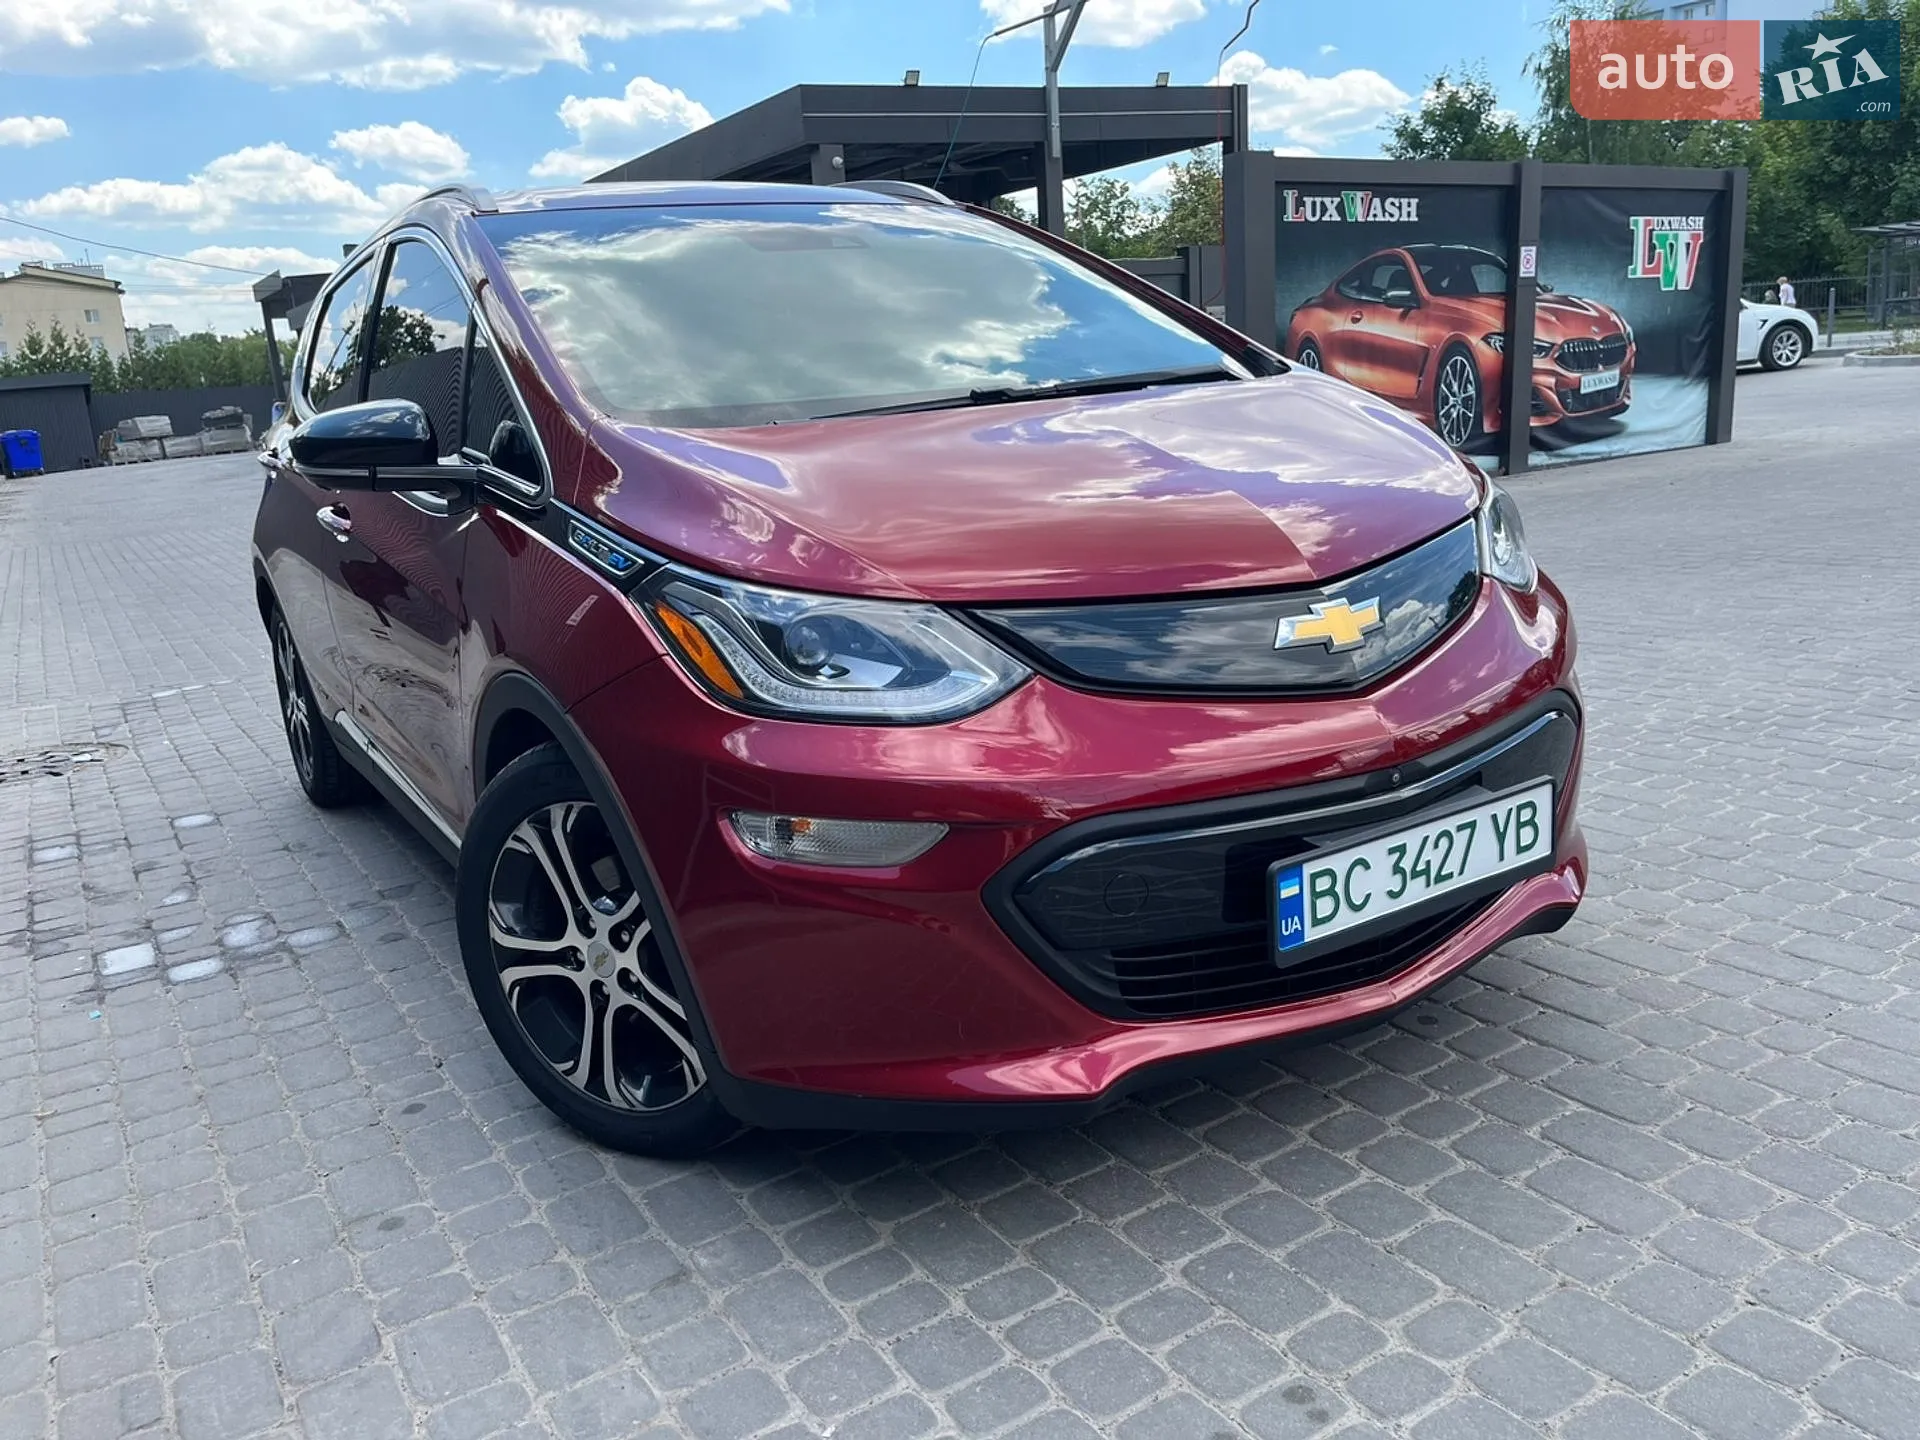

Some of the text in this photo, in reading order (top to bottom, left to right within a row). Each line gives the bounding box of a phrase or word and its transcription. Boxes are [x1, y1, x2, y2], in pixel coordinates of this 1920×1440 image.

[1309, 800, 1540, 928] BC 3427 YB
[1281, 917, 1302, 936] UA
